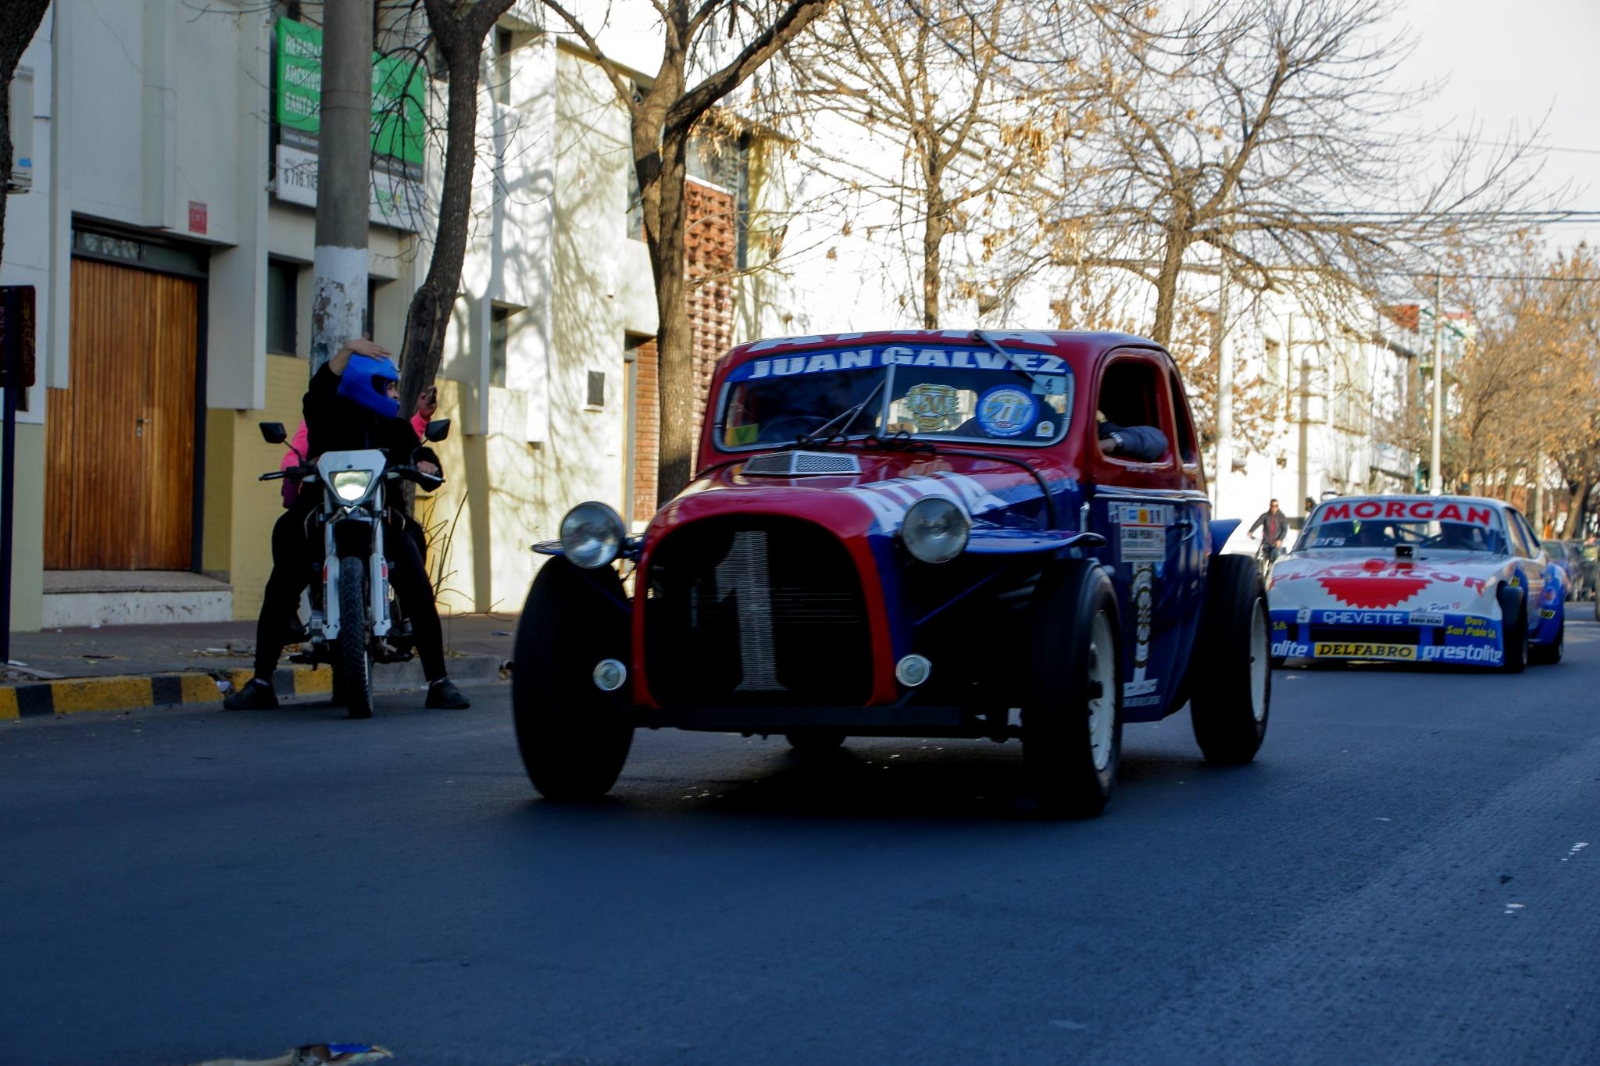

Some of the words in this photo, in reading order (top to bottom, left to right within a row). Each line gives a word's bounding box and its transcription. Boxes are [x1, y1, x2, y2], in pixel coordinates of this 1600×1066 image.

[748, 349, 873, 379] JUAN
[880, 346, 1066, 373] GALVEZ
[1322, 501, 1491, 526] MORGAN
[713, 531, 789, 692] 1
[1323, 611, 1403, 624] CHEVETTE
[1270, 640, 1308, 657] olite
[1319, 644, 1412, 658] DELFABRO
[1422, 645, 1503, 663] prestolite
